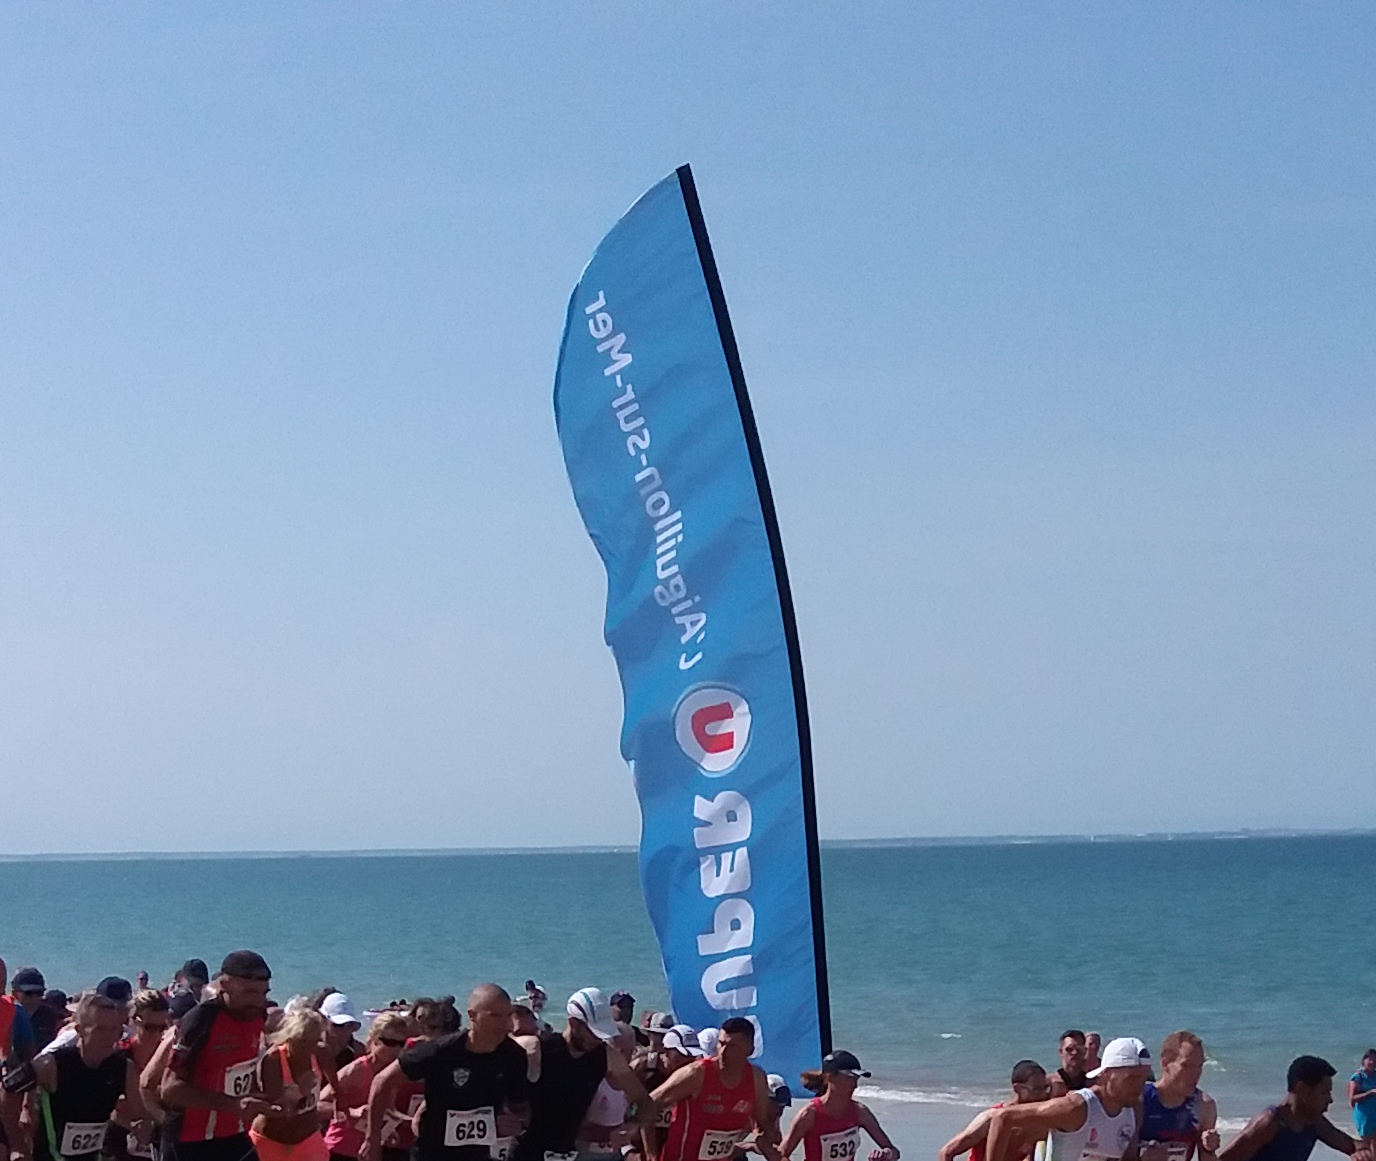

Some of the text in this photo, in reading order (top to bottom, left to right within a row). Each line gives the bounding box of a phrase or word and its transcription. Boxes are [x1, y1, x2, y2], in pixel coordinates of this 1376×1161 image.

[455, 1120, 487, 1140] 629
[707, 1140, 733, 1155] 539
[830, 1140, 855, 1158] 532
